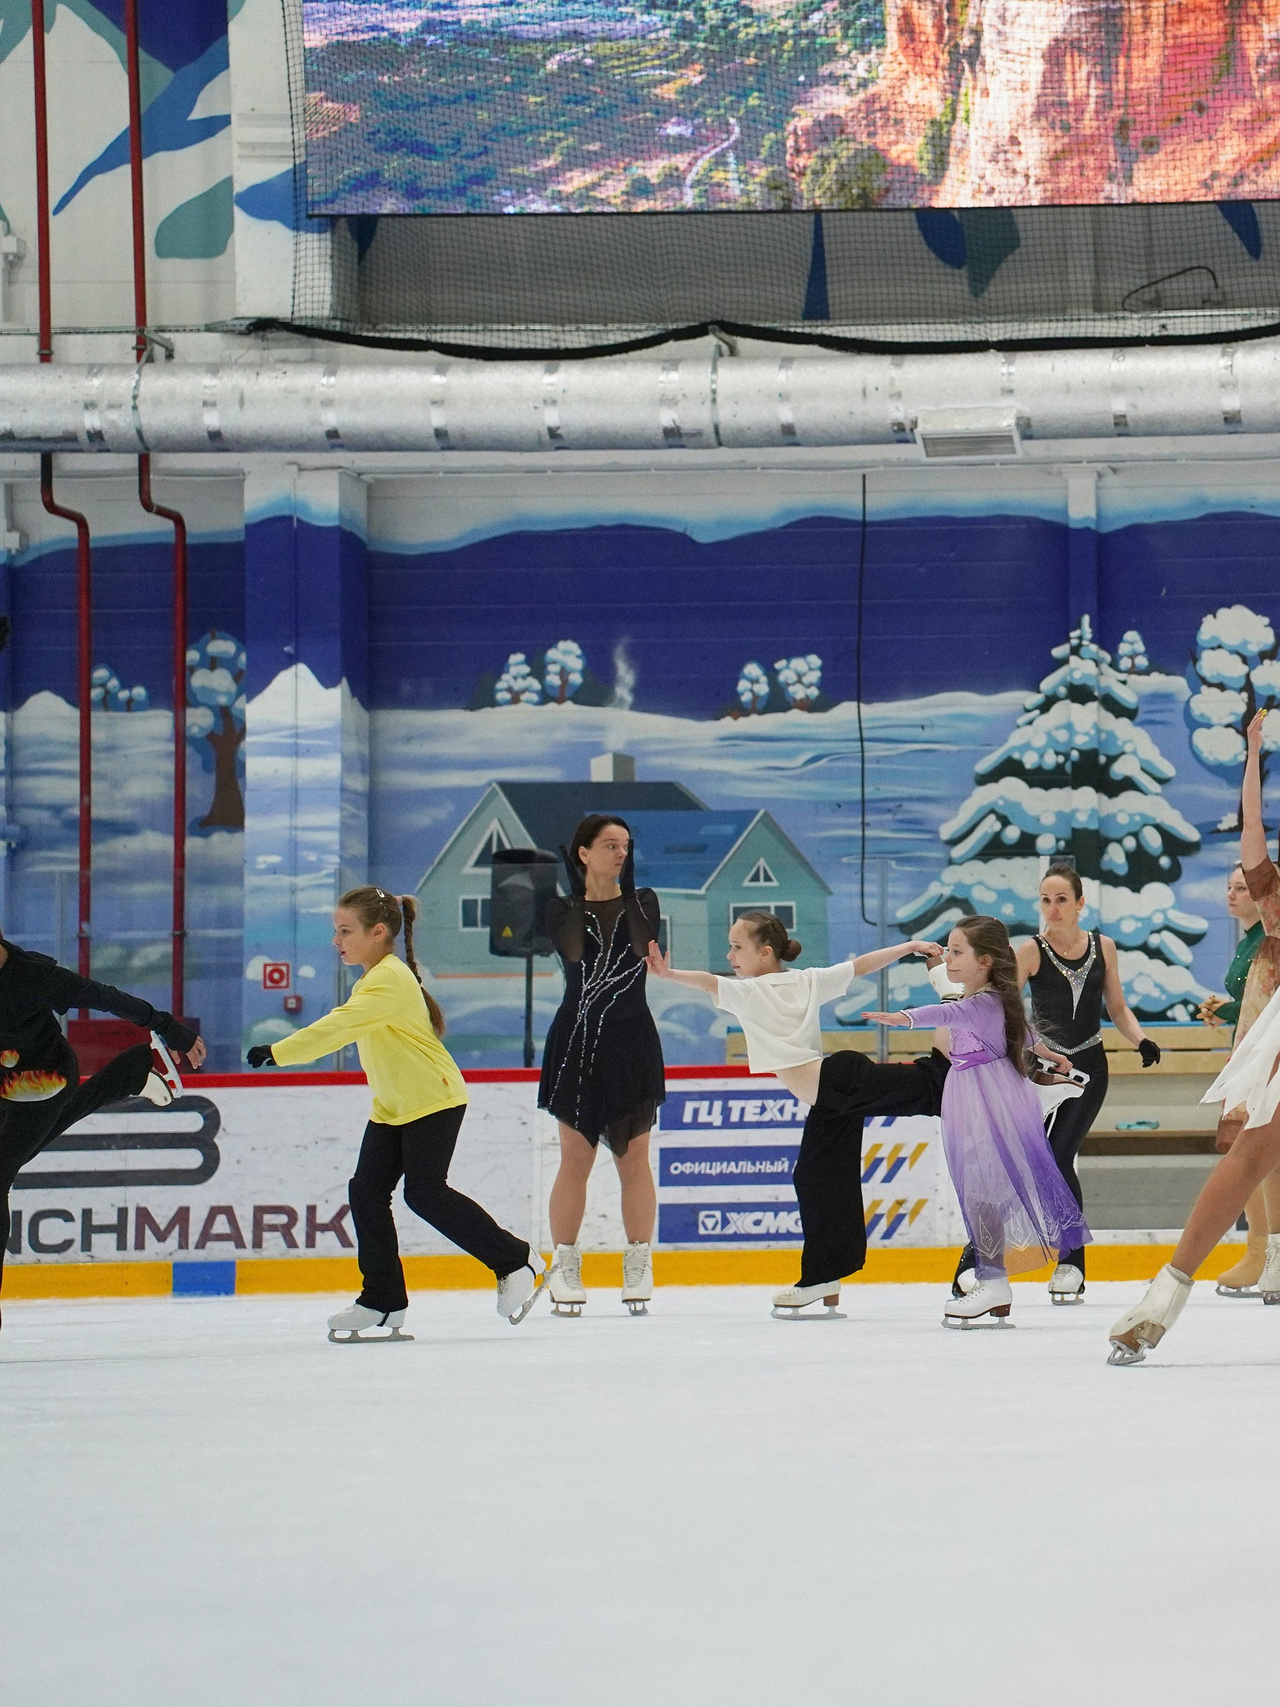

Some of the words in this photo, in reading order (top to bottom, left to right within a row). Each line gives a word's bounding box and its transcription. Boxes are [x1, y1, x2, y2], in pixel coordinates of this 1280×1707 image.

[683, 1100, 723, 1126] ГЦ
[728, 1099, 811, 1122] ТЕХН
[669, 1157, 789, 1176] ОФИЦИАЛЬНЫЙ
